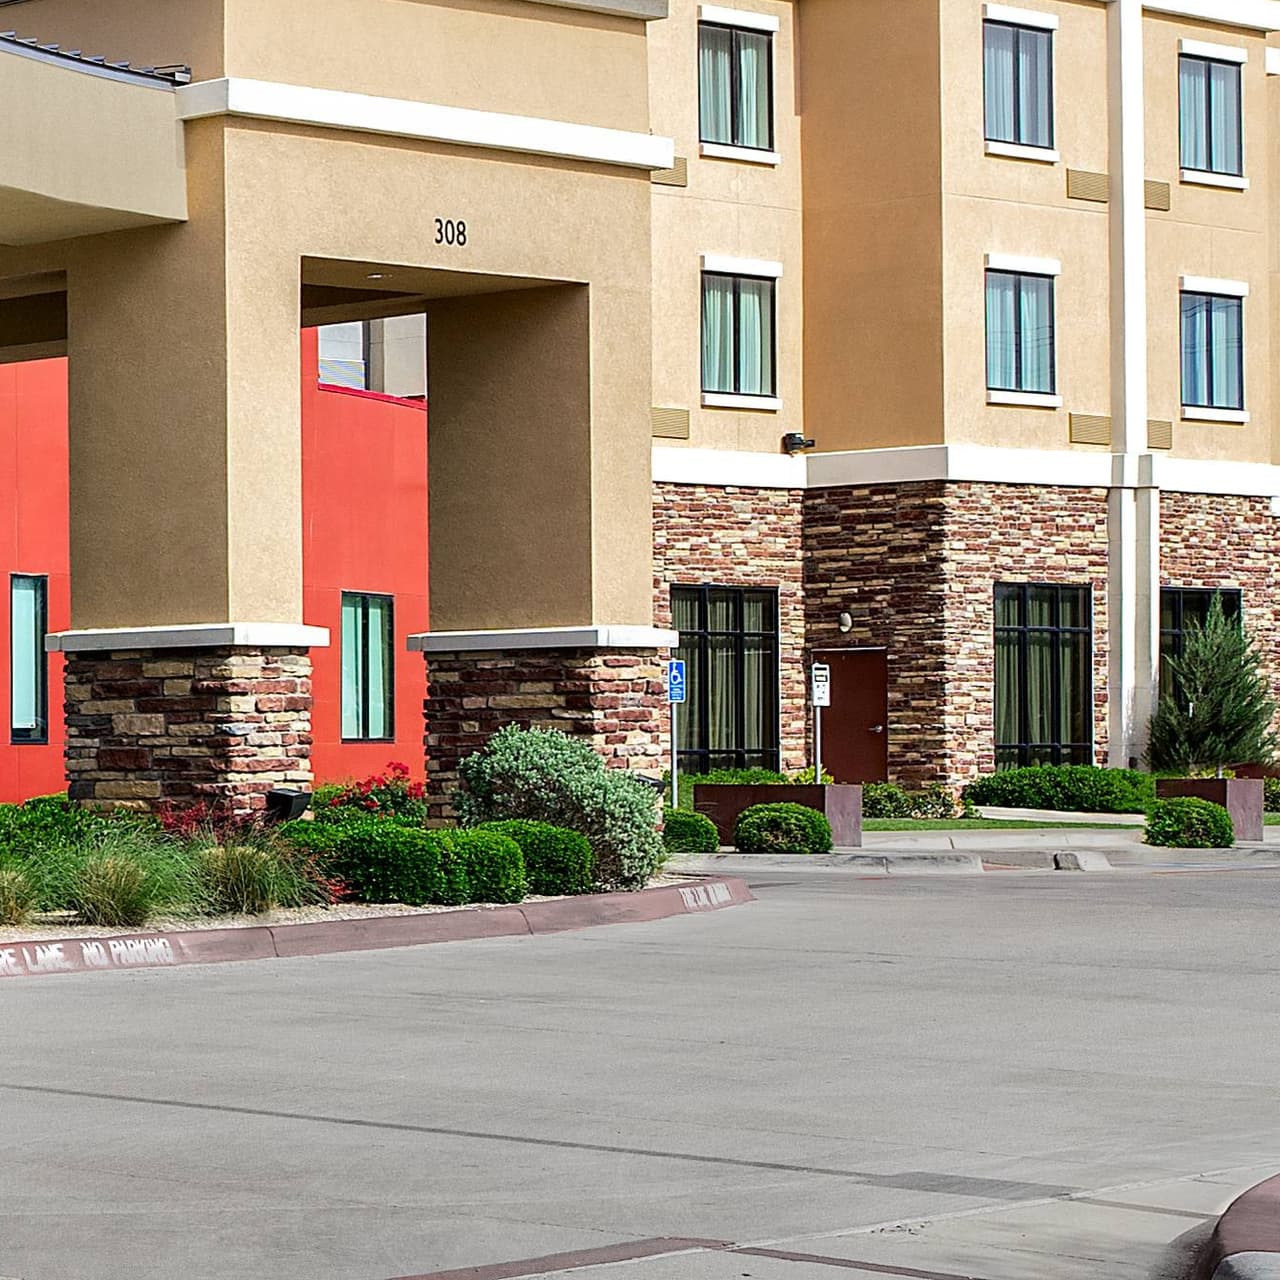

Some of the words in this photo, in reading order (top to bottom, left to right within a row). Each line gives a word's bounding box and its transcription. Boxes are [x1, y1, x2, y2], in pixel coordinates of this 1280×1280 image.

[434, 218, 467, 246] 308
[22, 943, 72, 973] LANE
[80, 942, 109, 968] NO
[108, 938, 174, 965] PARKING
